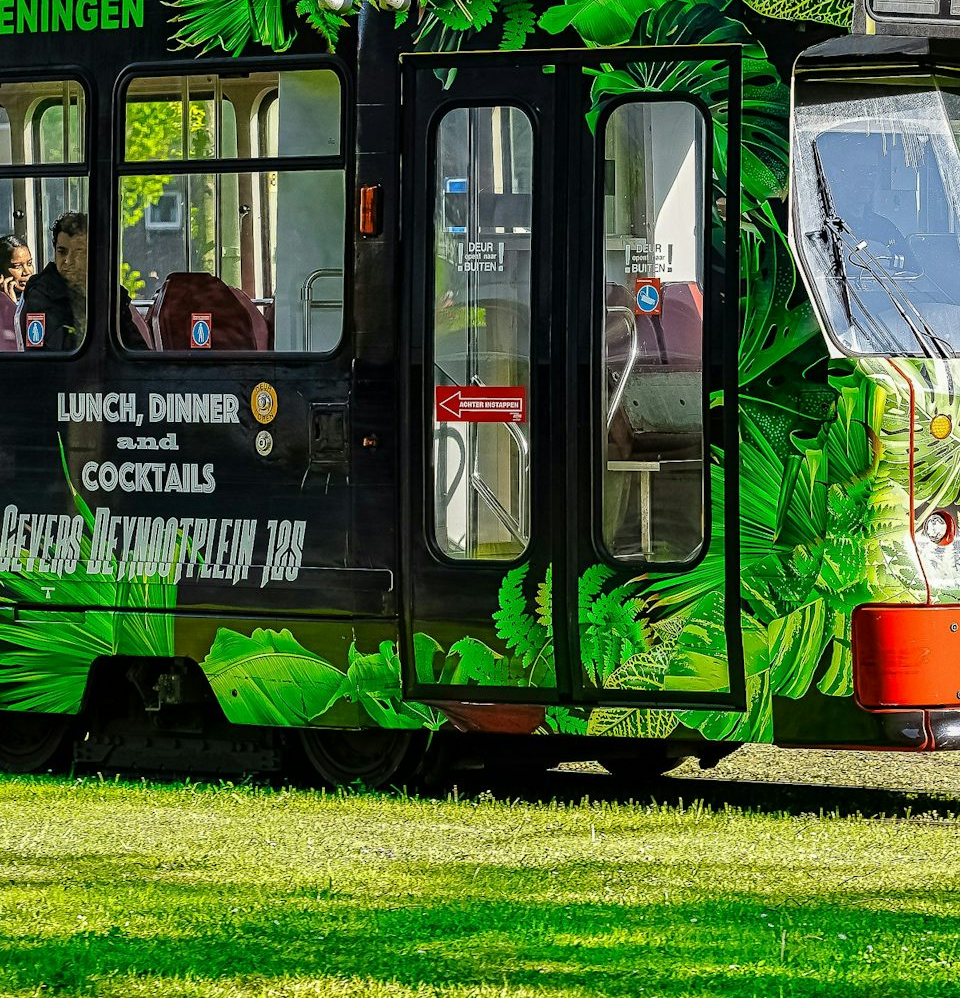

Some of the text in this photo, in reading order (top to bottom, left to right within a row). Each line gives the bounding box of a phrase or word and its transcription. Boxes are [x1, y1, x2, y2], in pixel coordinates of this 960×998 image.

[469, 242, 493, 252] DEUR
[636, 244, 662, 253] DEUR
[464, 262, 497, 272] BUITEN
[631, 263, 666, 273] BUITEN
[57, 392, 241, 426] LUNCH, DINNER
[116, 432, 180, 450] and
[81, 460, 216, 494] COCKTAILS
[260, 519, 307, 589] 125
